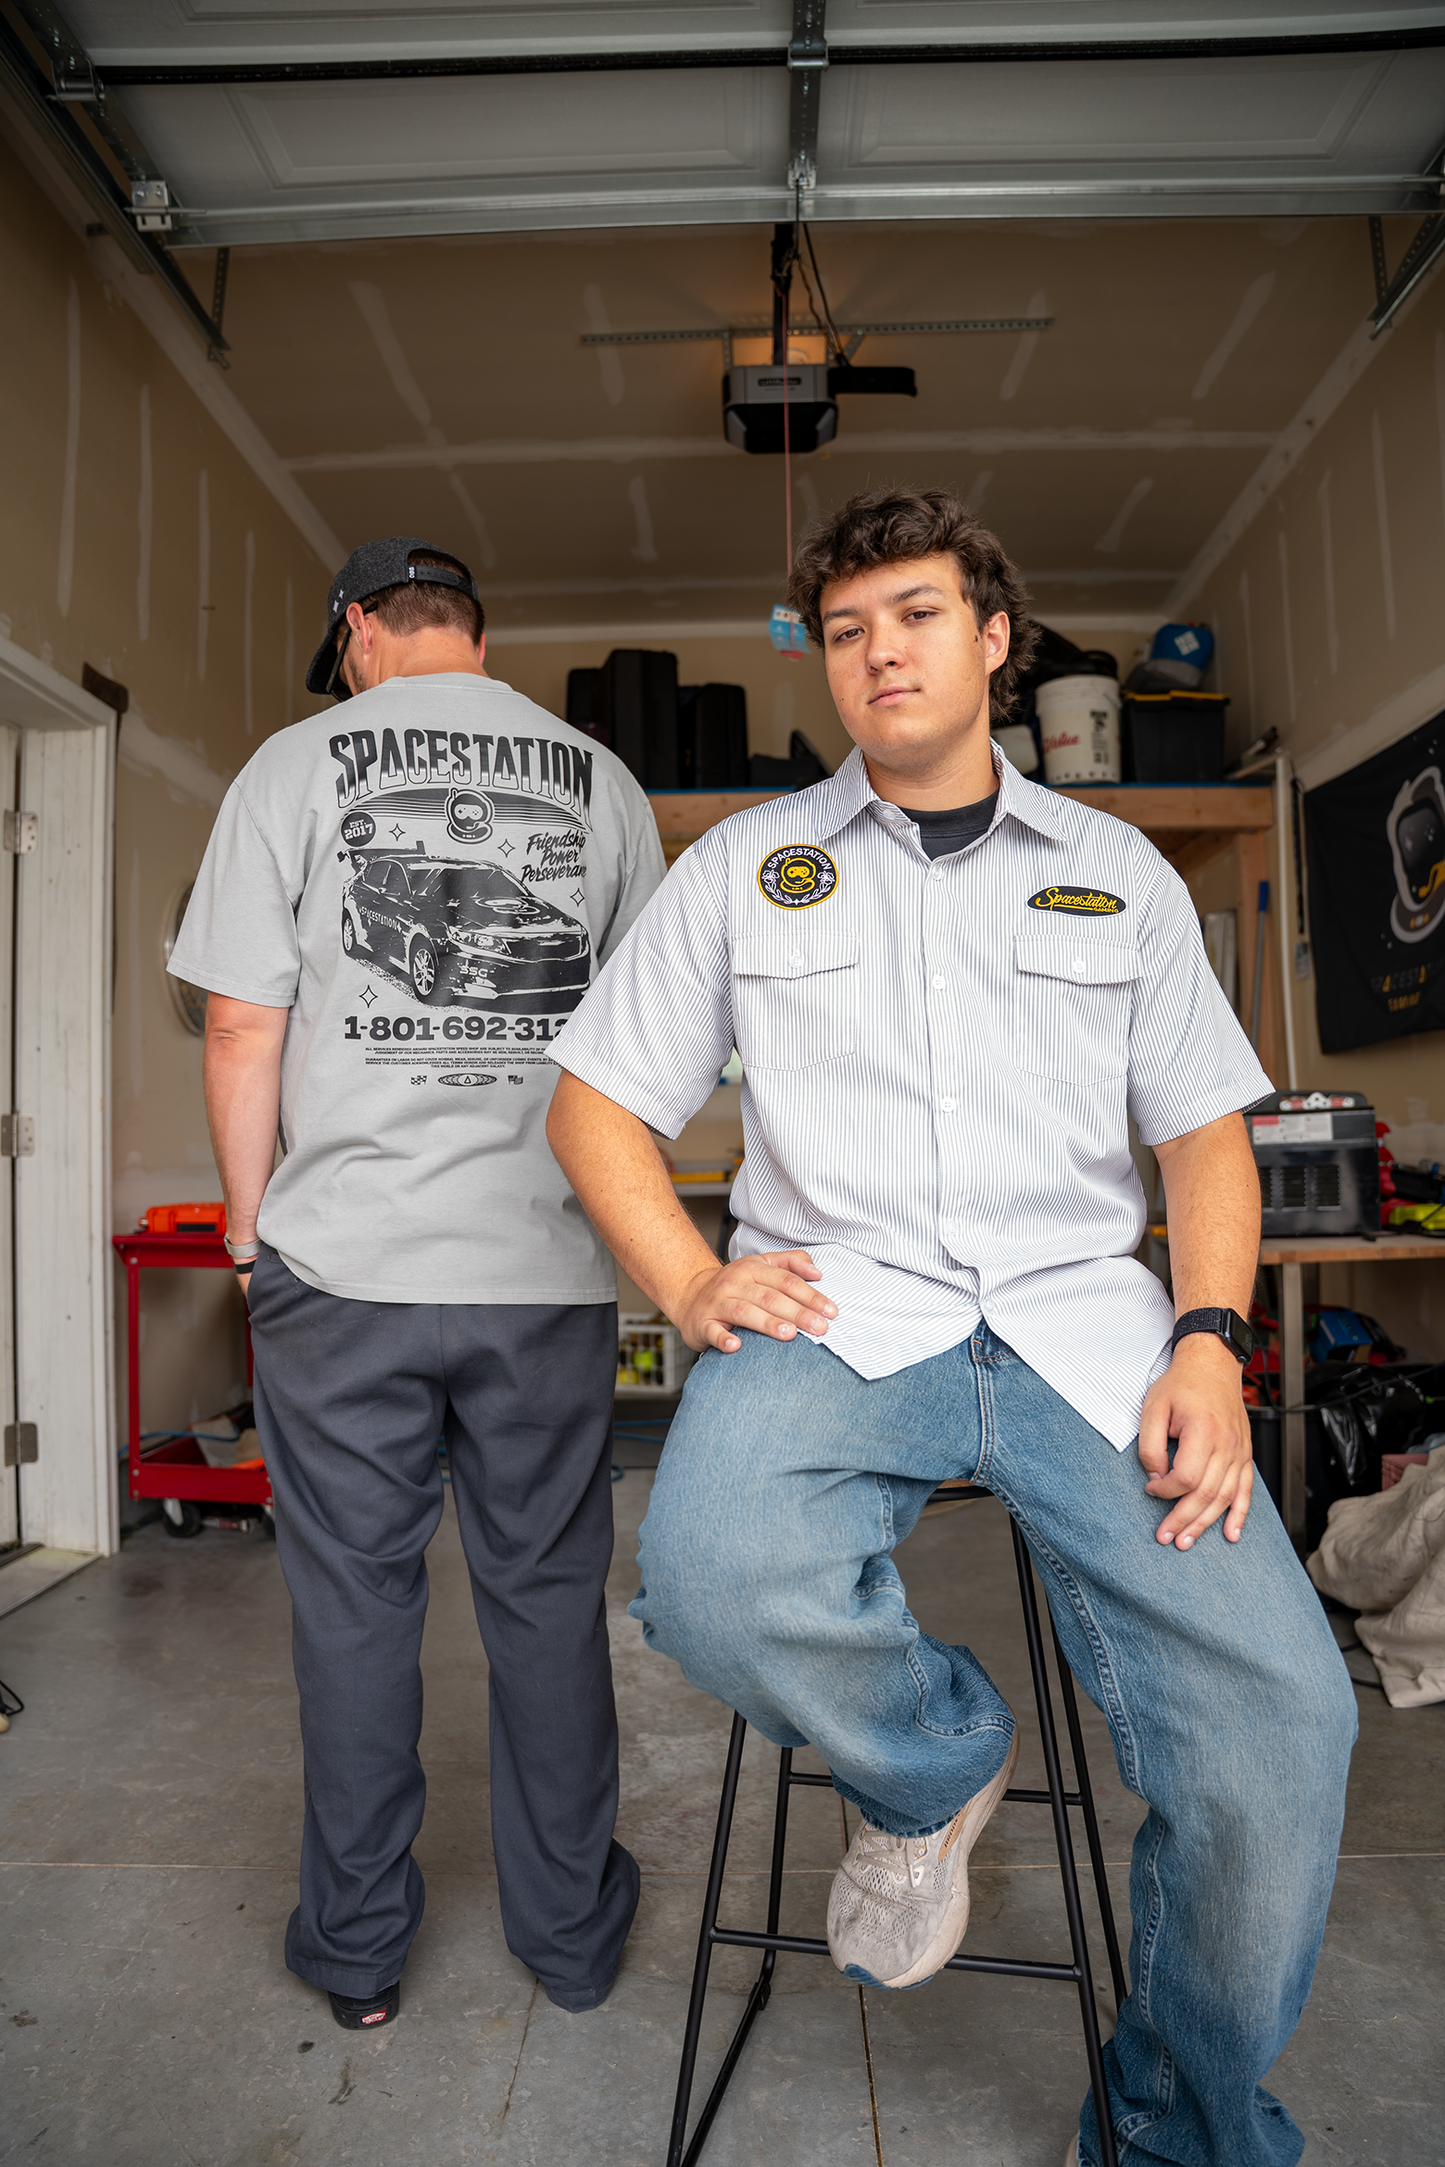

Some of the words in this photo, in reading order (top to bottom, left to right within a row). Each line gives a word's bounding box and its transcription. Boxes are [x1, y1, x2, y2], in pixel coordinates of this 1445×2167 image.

[329, 727, 594, 832] SPACESTATION
[343, 823, 373, 840] 2017
[349, 819, 367, 829] EST.
[526, 829, 587, 855] Friendship
[540, 847, 579, 869] Power
[767, 847, 833, 870] SPACESTATION
[1035, 887, 1118, 911] Spacestation
